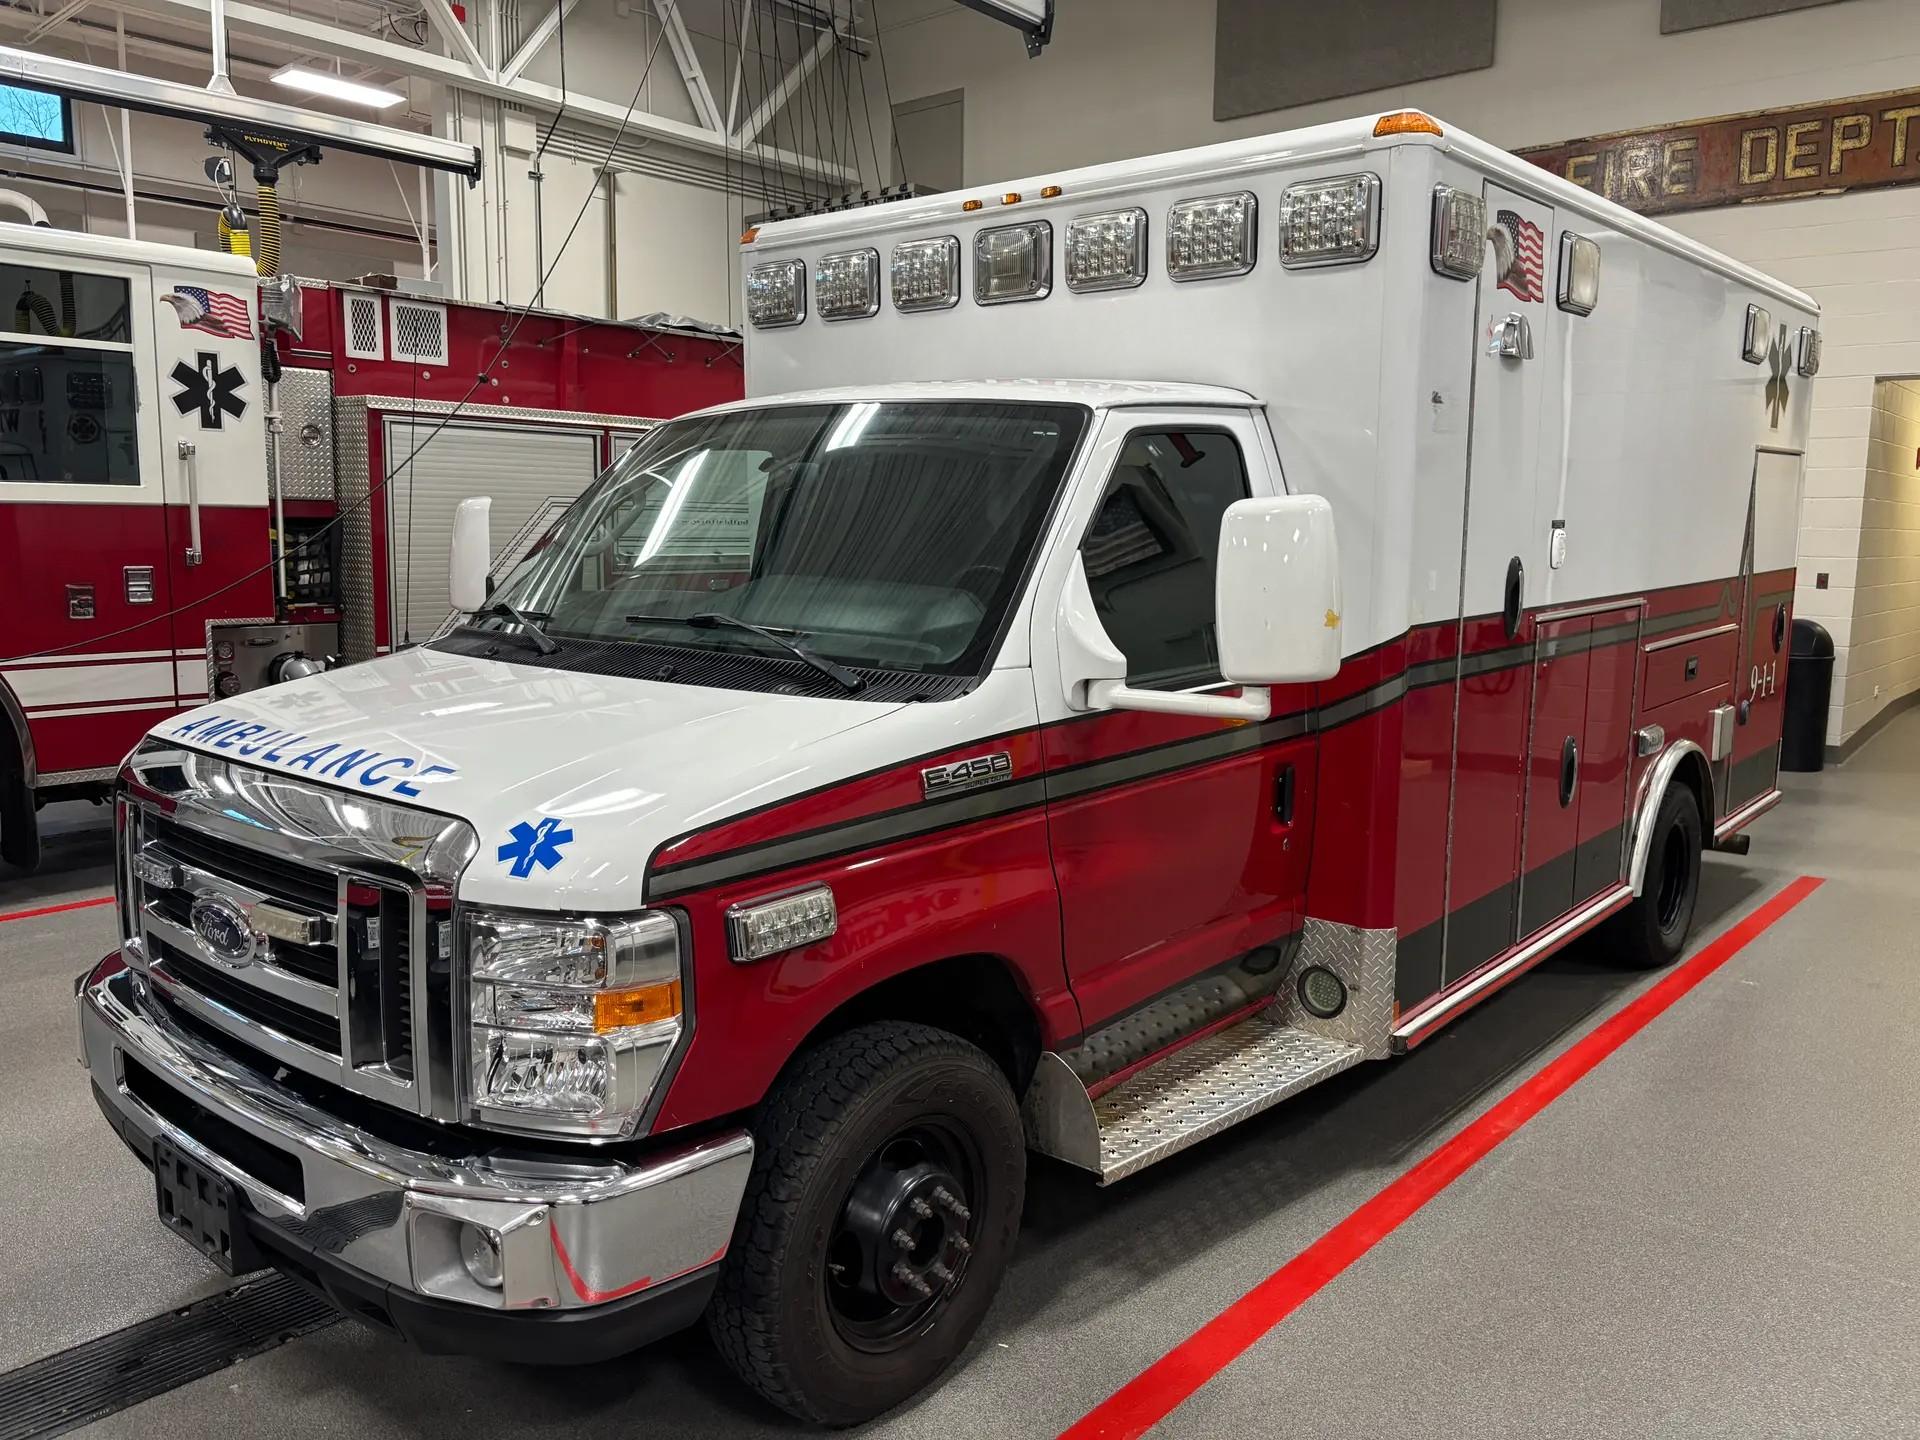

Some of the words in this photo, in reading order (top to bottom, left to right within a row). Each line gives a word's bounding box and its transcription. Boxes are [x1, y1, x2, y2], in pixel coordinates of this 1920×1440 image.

[1564, 137, 1697, 201] FIRE
[1749, 660, 1777, 703] 9-1-1
[171, 715, 458, 797] AMBULANCE
[200, 911, 230, 946] Ford
